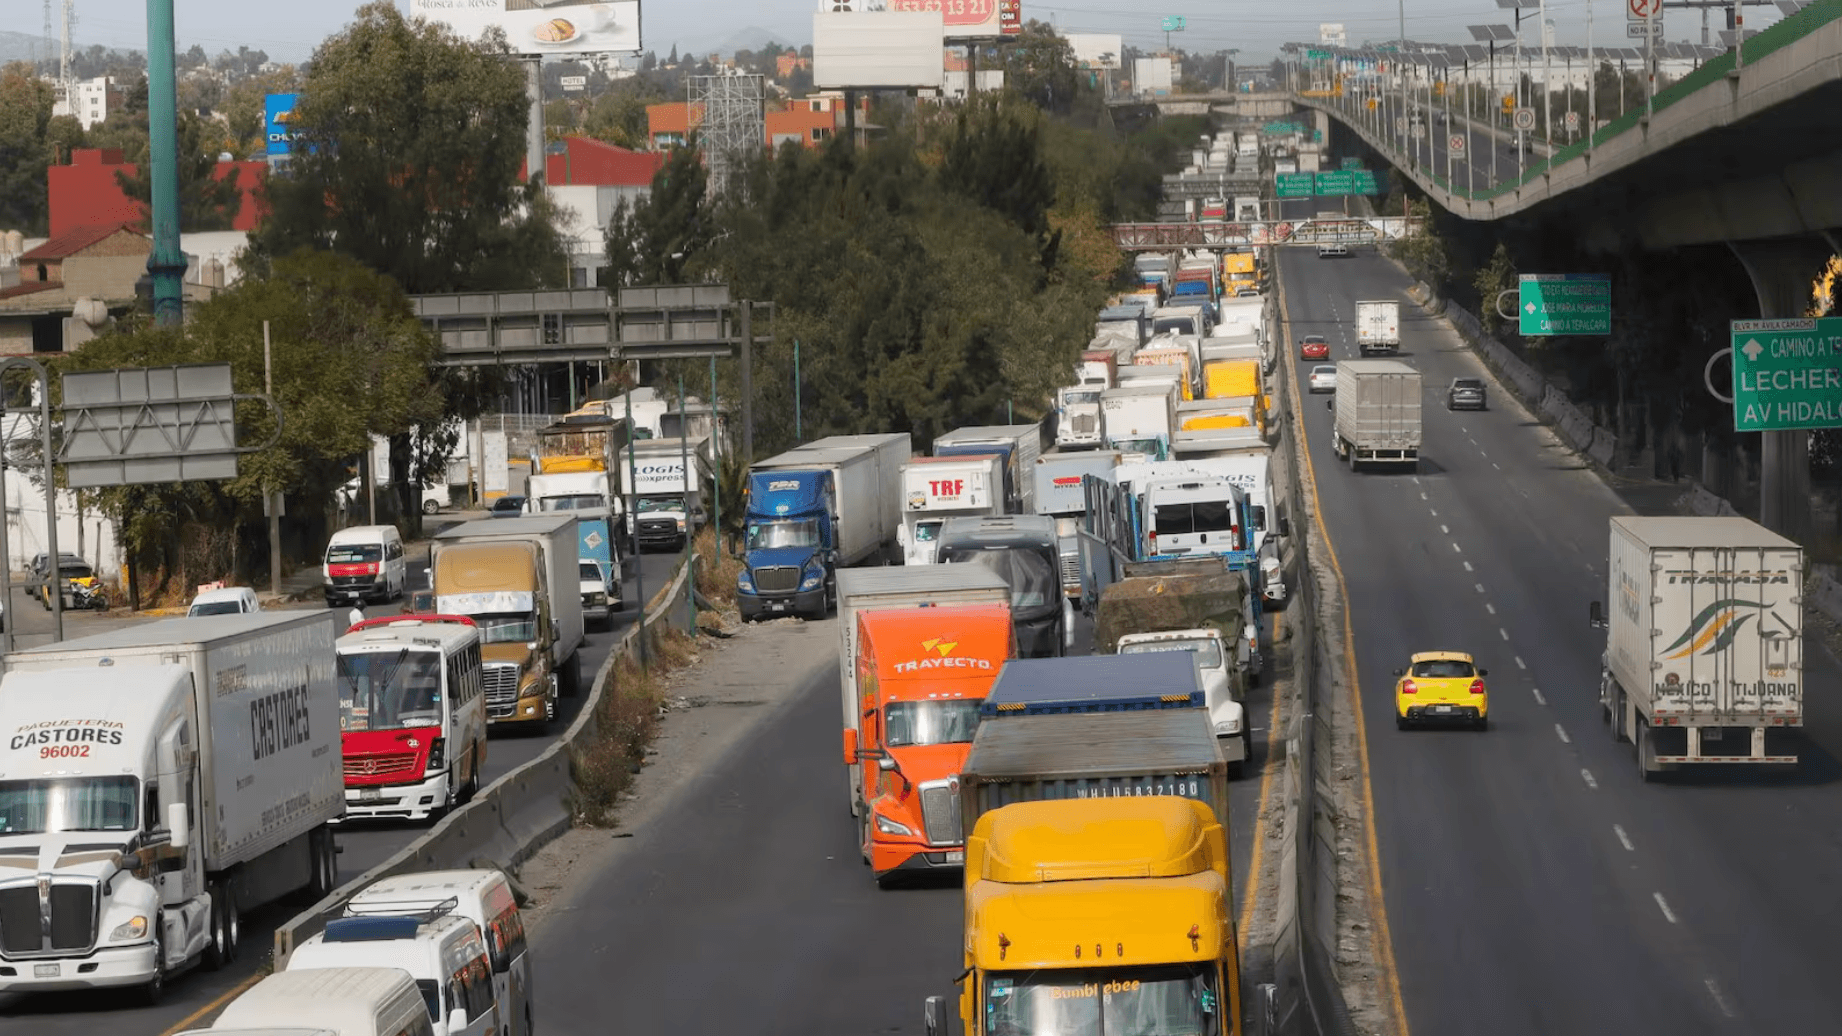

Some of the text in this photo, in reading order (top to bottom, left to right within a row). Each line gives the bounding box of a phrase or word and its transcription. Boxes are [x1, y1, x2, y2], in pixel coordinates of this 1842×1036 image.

[948, 1, 966, 14] 13
[969, 1, 987, 14] 21
[1781, 320, 1814, 329] CAMACHO
[1770, 337, 1815, 359] CAMINO
[1817, 337, 1826, 357] A
[1741, 368, 1841, 392] LECHER
[1743, 402, 1772, 424] AV
[928, 479, 963, 497] TRF
[1665, 570, 1789, 584] TRACASA
[894, 657, 991, 674] TRAYECTO
[1736, 682, 1797, 696] TIJUANA
[16, 719, 124, 733] PAQUETERIA
[250, 684, 310, 761] CASTORES
[10, 728, 123, 750] CASTORES
[39, 745, 90, 759] 96002
